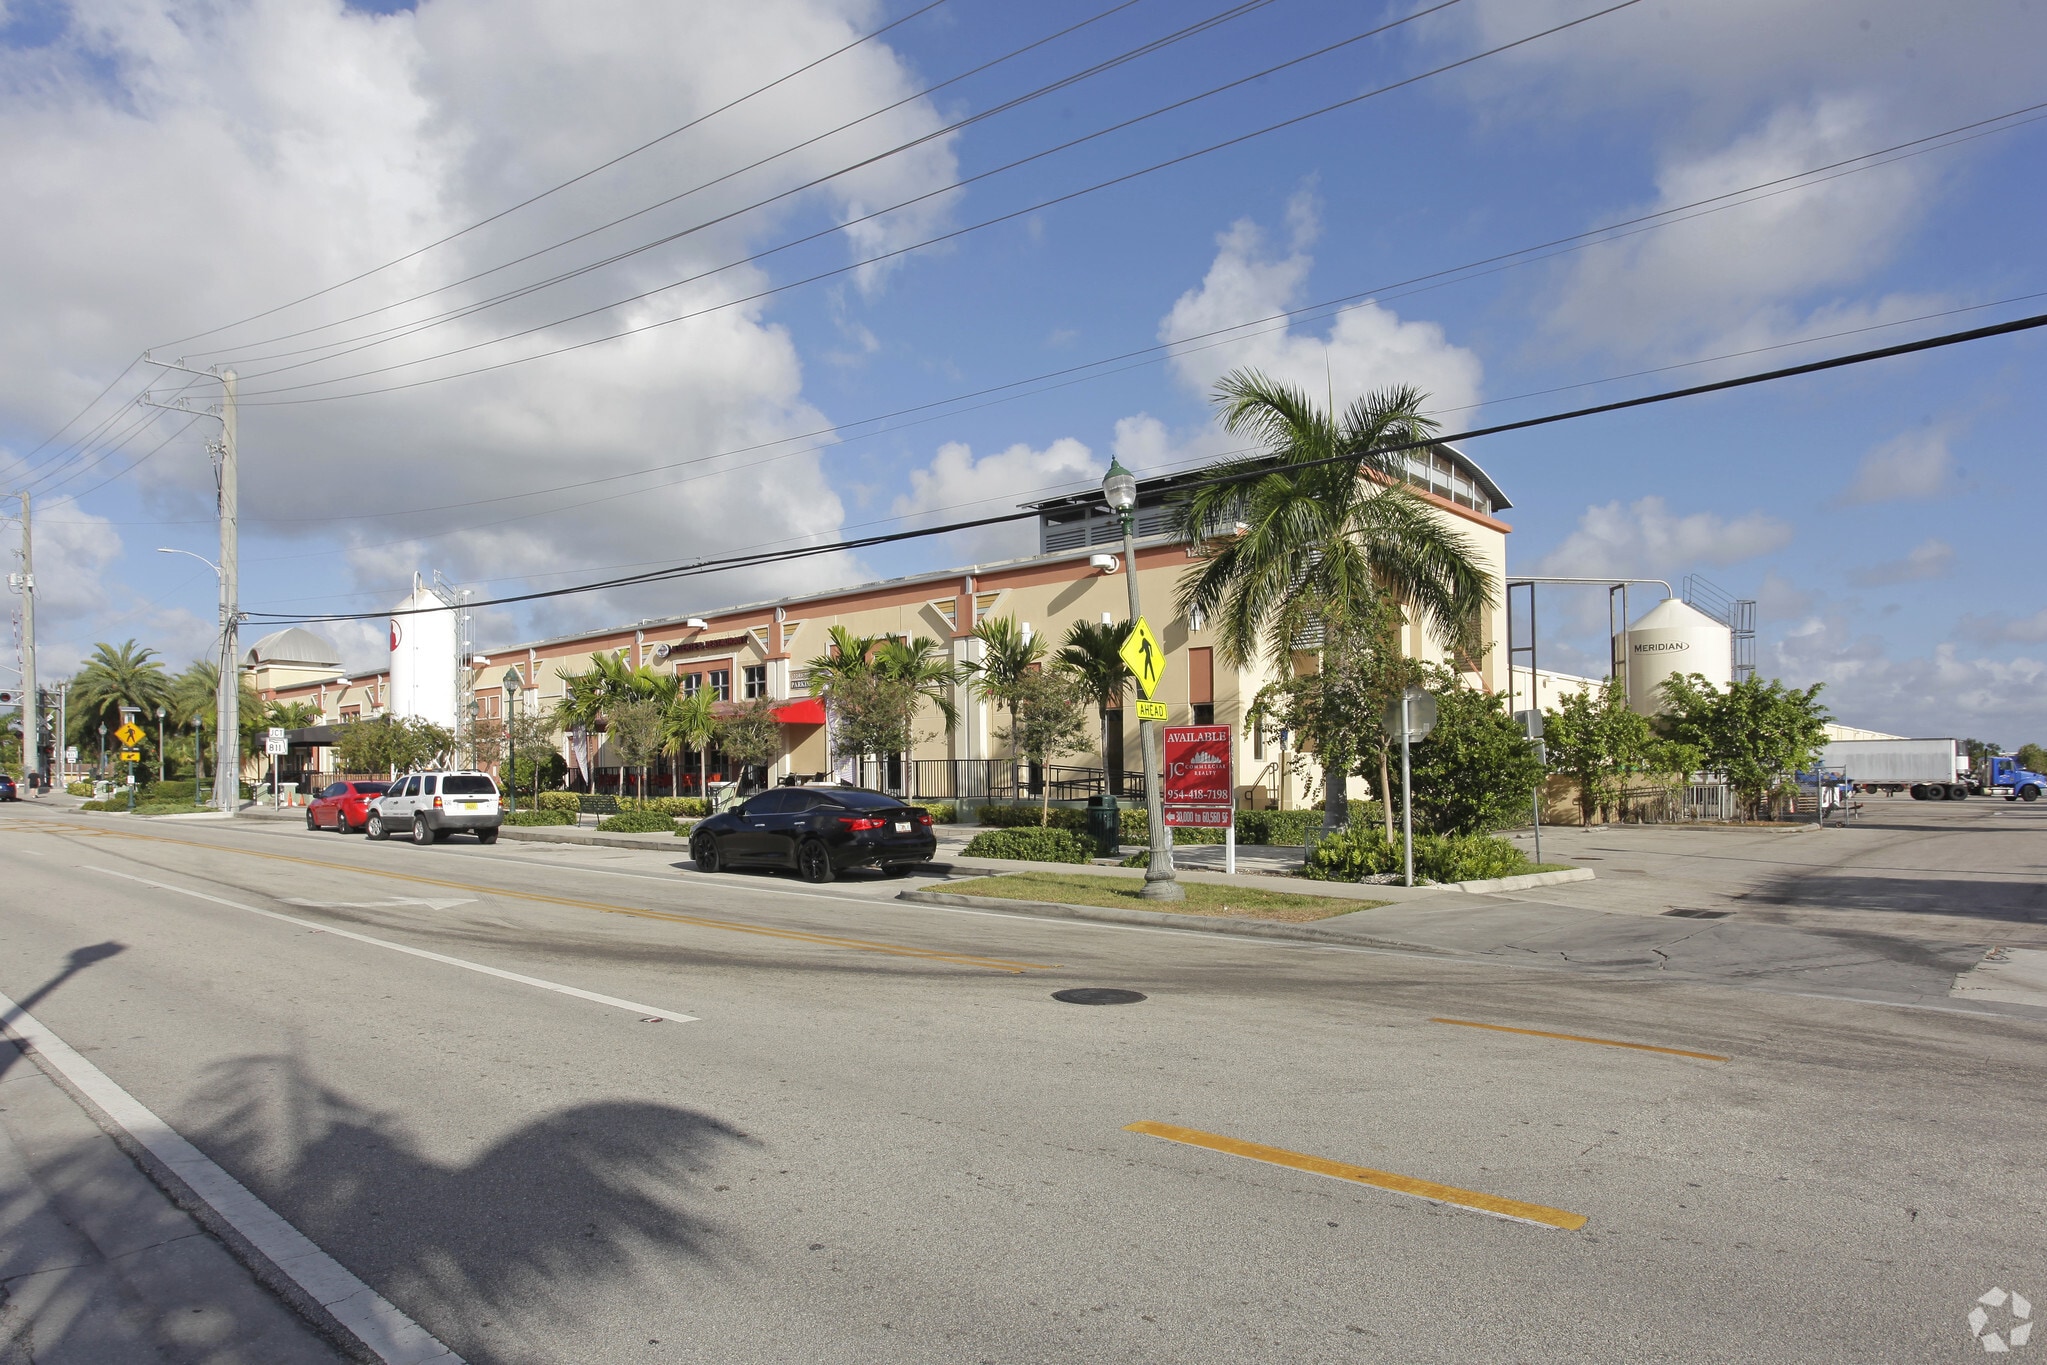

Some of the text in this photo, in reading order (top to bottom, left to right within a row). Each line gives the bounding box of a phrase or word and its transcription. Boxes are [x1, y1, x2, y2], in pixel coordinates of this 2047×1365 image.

[1634, 643, 1683, 653] MERIDIAN
[1140, 703, 1164, 717] AHEAD
[270, 729, 283, 737] JCT
[1167, 731, 1227, 742] AVAILABLE
[269, 743, 282, 752] 811
[1168, 762, 1185, 779] JC
[1167, 789, 1228, 799] 954-418-7198
[1195, 812, 1201, 822] to
